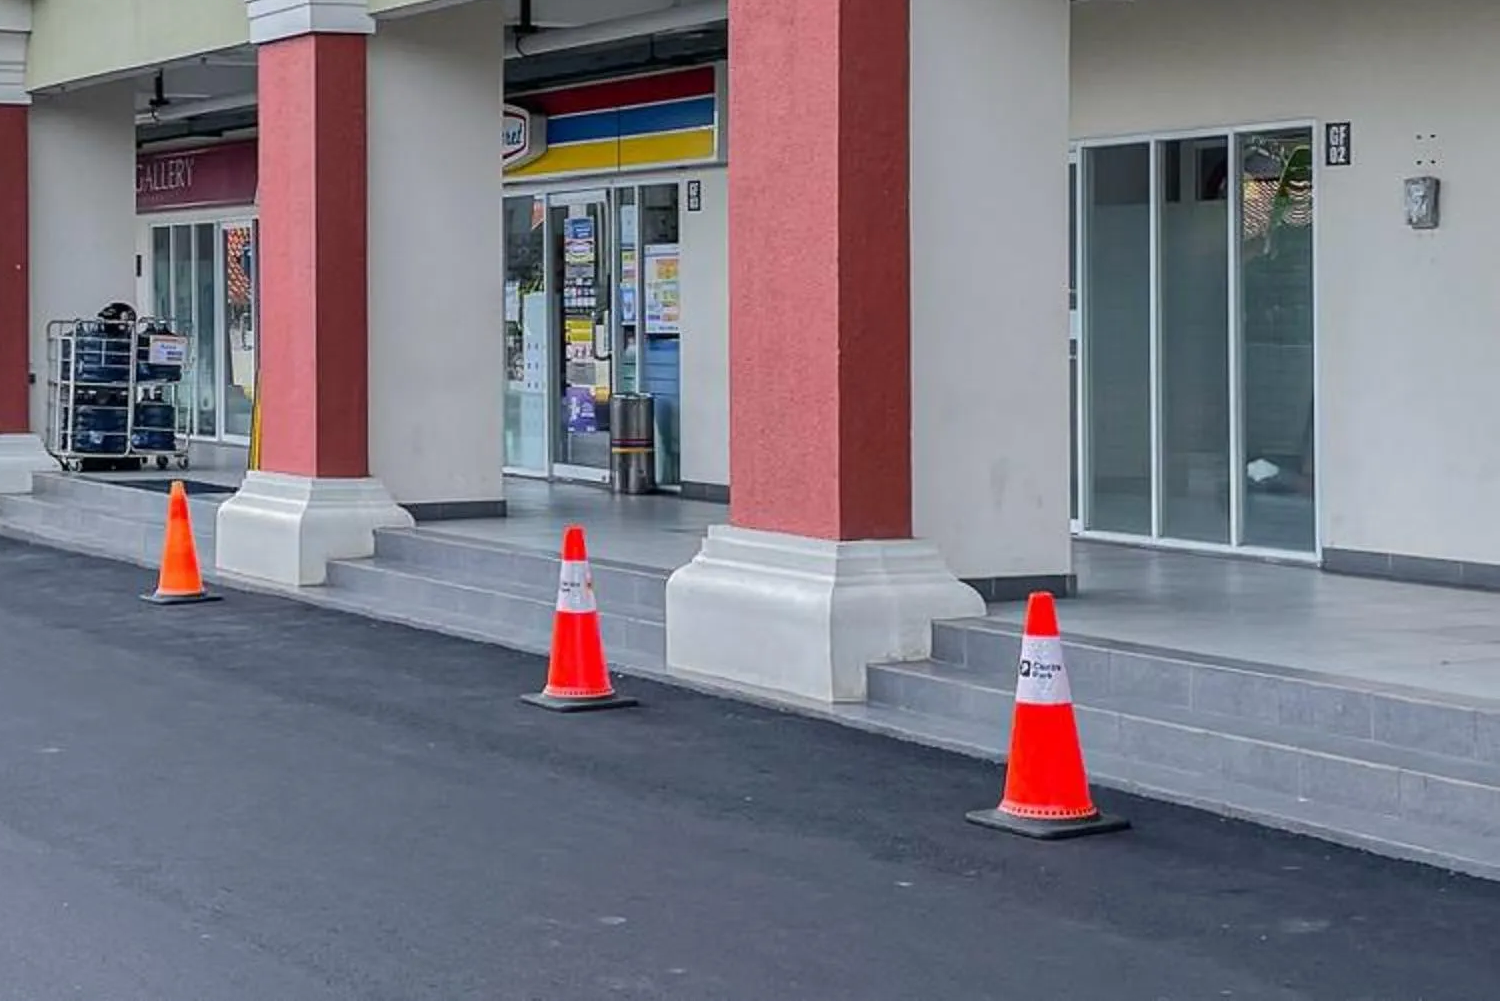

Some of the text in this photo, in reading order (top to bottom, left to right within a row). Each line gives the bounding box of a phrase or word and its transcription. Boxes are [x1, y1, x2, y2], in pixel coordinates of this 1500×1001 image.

[1329, 126, 1347, 146] GF
[1329, 146, 1346, 164] 02
[136, 158, 195, 192] GALLERY
